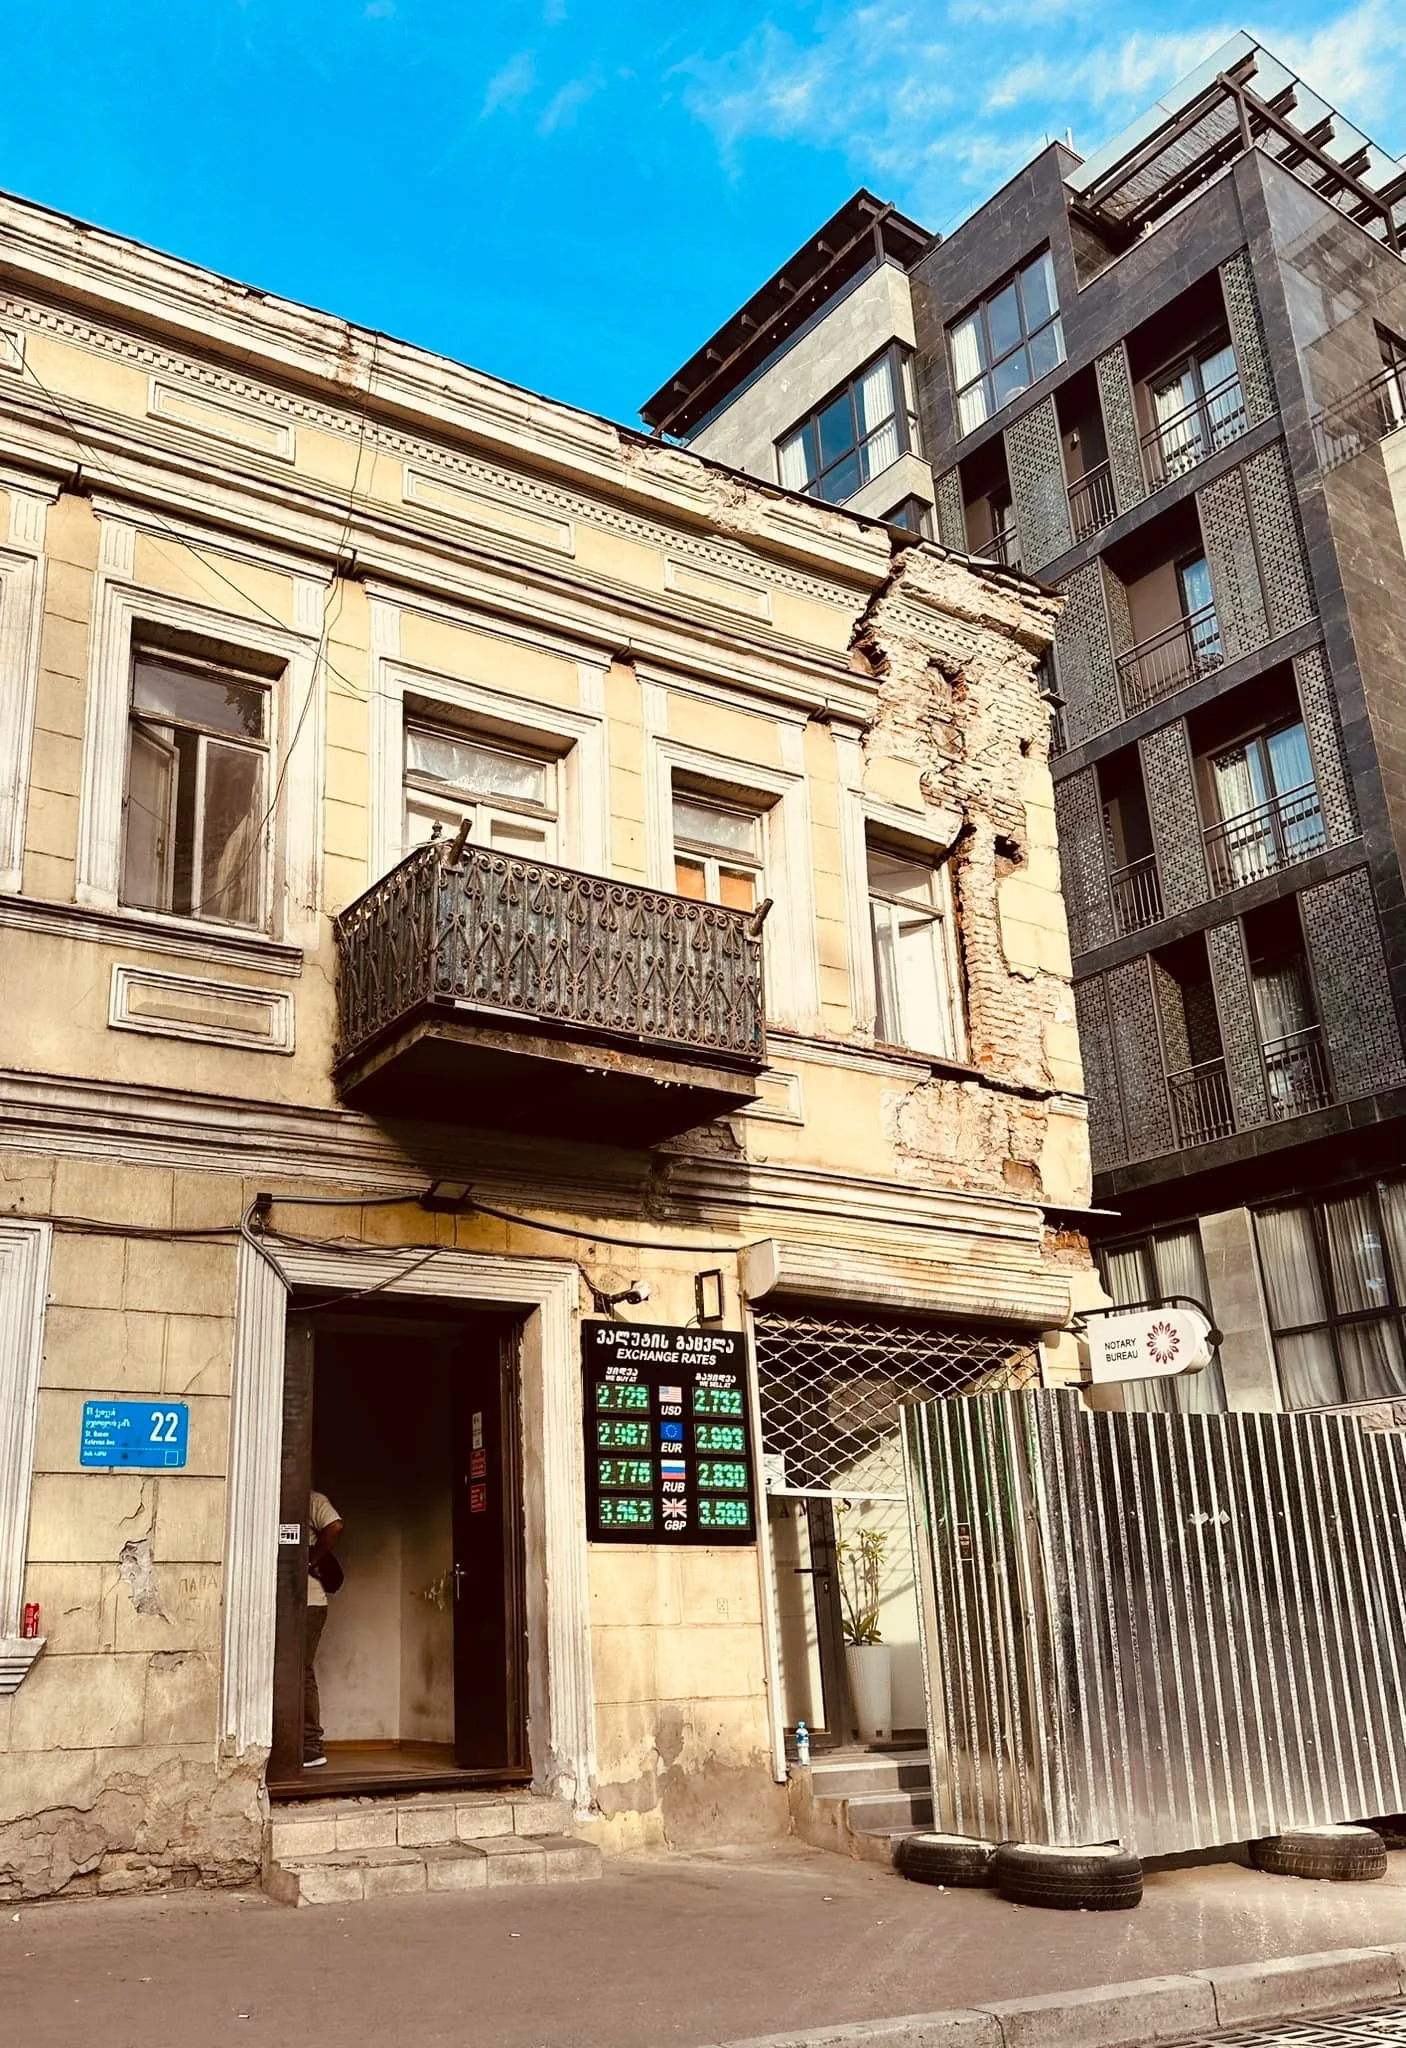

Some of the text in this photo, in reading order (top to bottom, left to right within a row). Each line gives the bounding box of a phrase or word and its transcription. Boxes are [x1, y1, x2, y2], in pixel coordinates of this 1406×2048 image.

[596, 1329, 734, 1354] ვალუტის გაცვლა
[1104, 1338, 1137, 1350] NOTARY
[616, 1348, 717, 1366] EXCHANGE RATES
[1105, 1350, 1138, 1362] BUREAU
[661, 1405, 682, 1416] USD
[149, 1411, 179, 1443] 22
[660, 1442, 682, 1453] EUR
[662, 1481, 685, 1493] RUB
[664, 1520, 686, 1531] GBP
